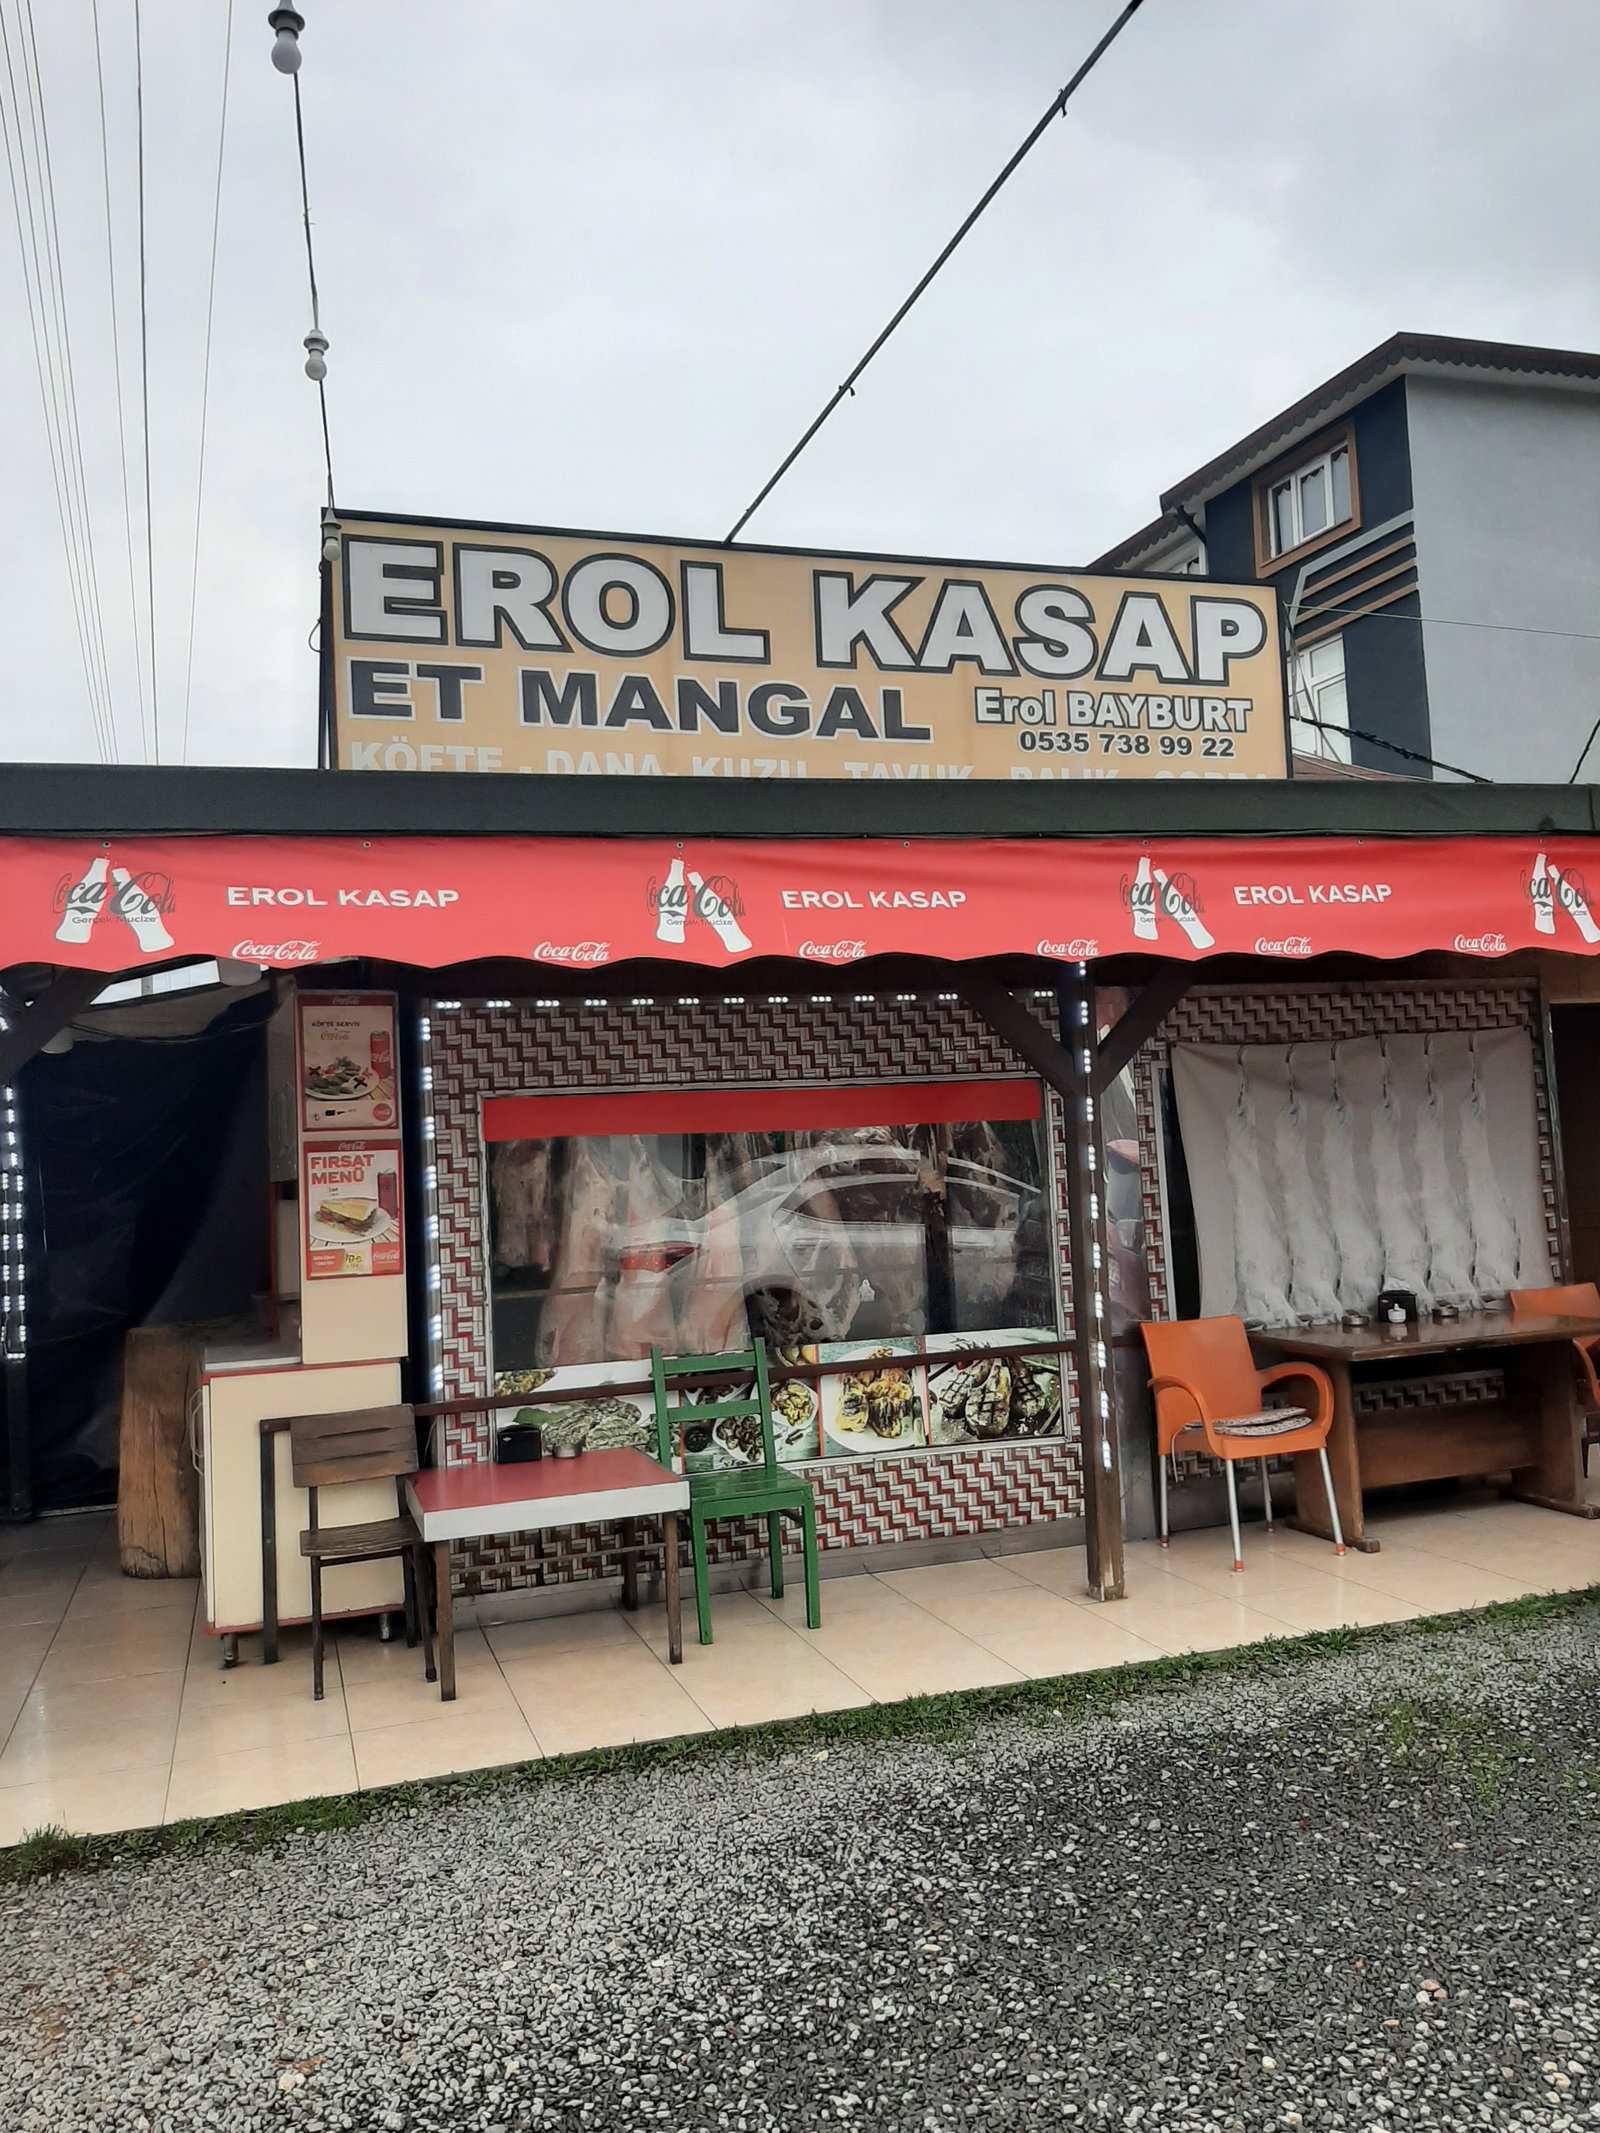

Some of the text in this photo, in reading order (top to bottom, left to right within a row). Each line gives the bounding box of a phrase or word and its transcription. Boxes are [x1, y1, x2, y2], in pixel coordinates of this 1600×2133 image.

[341, 534, 1267, 687] EROL KASAP
[348, 658, 933, 743] ET MANGAL
[974, 687, 1253, 733] Erol BAYBURT
[1020, 730, 1235, 757] 0535 738 99 22
[227, 886, 459, 908] EROL KASAP
[781, 890, 967, 909] EROL KASAP
[1233, 884, 1392, 906] EROL KASAP
[231, 939, 322, 960] Coca-Cola
[533, 941, 612, 961] Coca-Cola
[799, 940, 868, 959] Coca-Cola
[1037, 939, 1099, 957] Coca-Cola
[1254, 936, 1312, 955] Coca-Cola
[1454, 933, 1507, 952] Coca-Cola
[310, 1154, 374, 1169] FIRSAT
[311, 1167, 365, 1185] MENÜ
